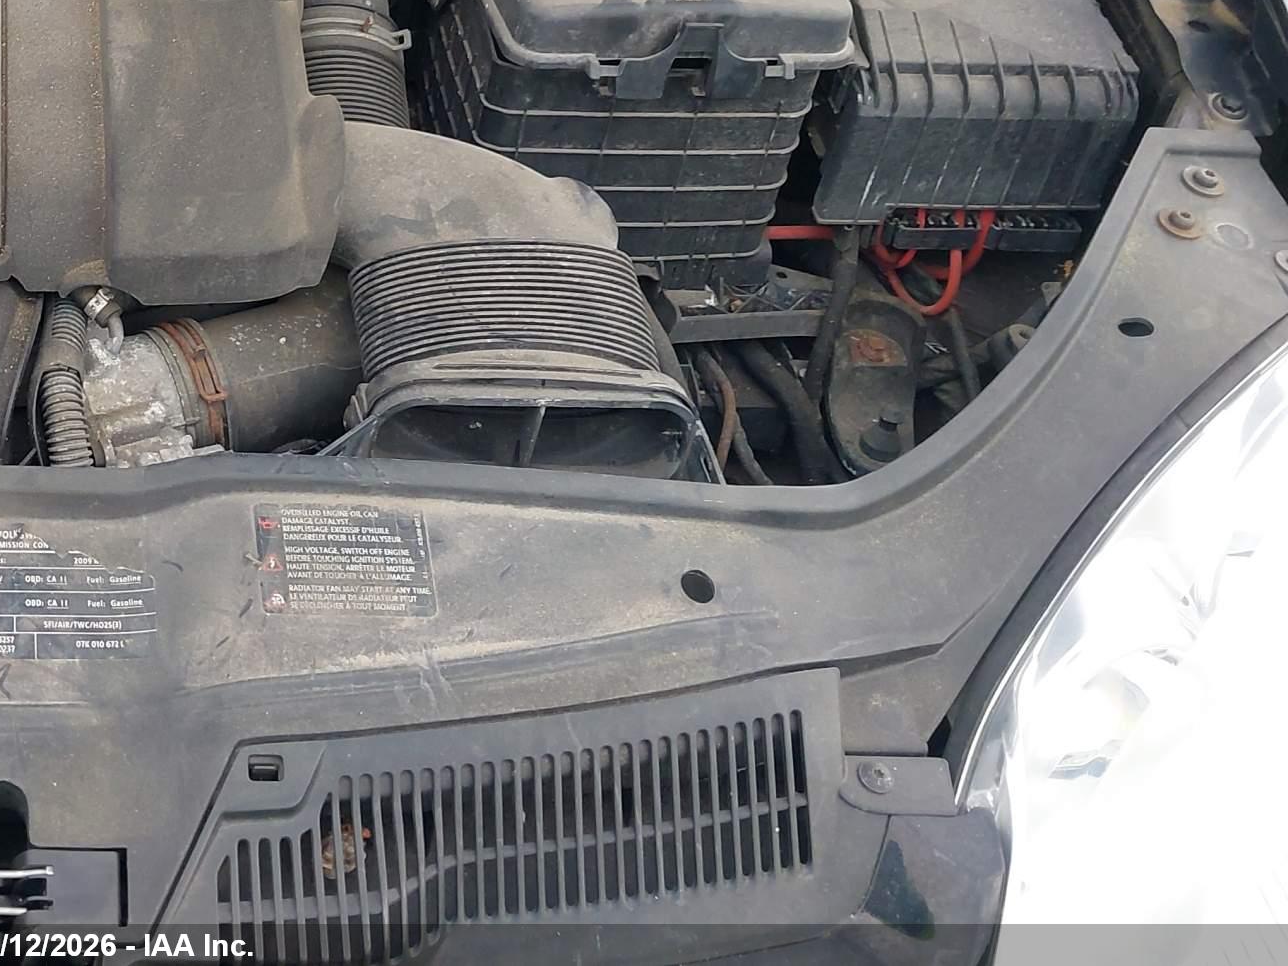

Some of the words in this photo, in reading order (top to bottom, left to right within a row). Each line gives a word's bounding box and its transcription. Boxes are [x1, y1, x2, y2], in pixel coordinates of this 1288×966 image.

[323, 509, 348, 517] ENGINE
[350, 510, 363, 518] OIL
[282, 525, 329, 533] REMPLISSAGE
[331, 526, 360, 534] EXCESSIF
[283, 533, 327, 541] DANGEREUX
[328, 534, 346, 542] POUR
[285, 546, 304, 554] HIGH
[73, 557, 92, 565] 2009
[286, 554, 312, 562] BEFORE
[313, 555, 350, 563] TOUCHING
[351, 555, 384, 563] IGNITION
[386, 565, 416, 573] MOTEUR
[287, 571, 312, 579] AVANT
[25, 575, 43, 583] OBD:
[87, 576, 104, 584] Fuel:
[110, 575, 141, 583] Gasoline
[298, 593, 346, 601] VENTILATEUR
[25, 599, 44, 607] OBD:
[47, 599, 57, 607] CA
[87, 599, 105, 607] Fuel:
[110, 598, 143, 607] Gasoline
[91, 640, 104, 648] 010
[106, 640, 119, 648] 672
